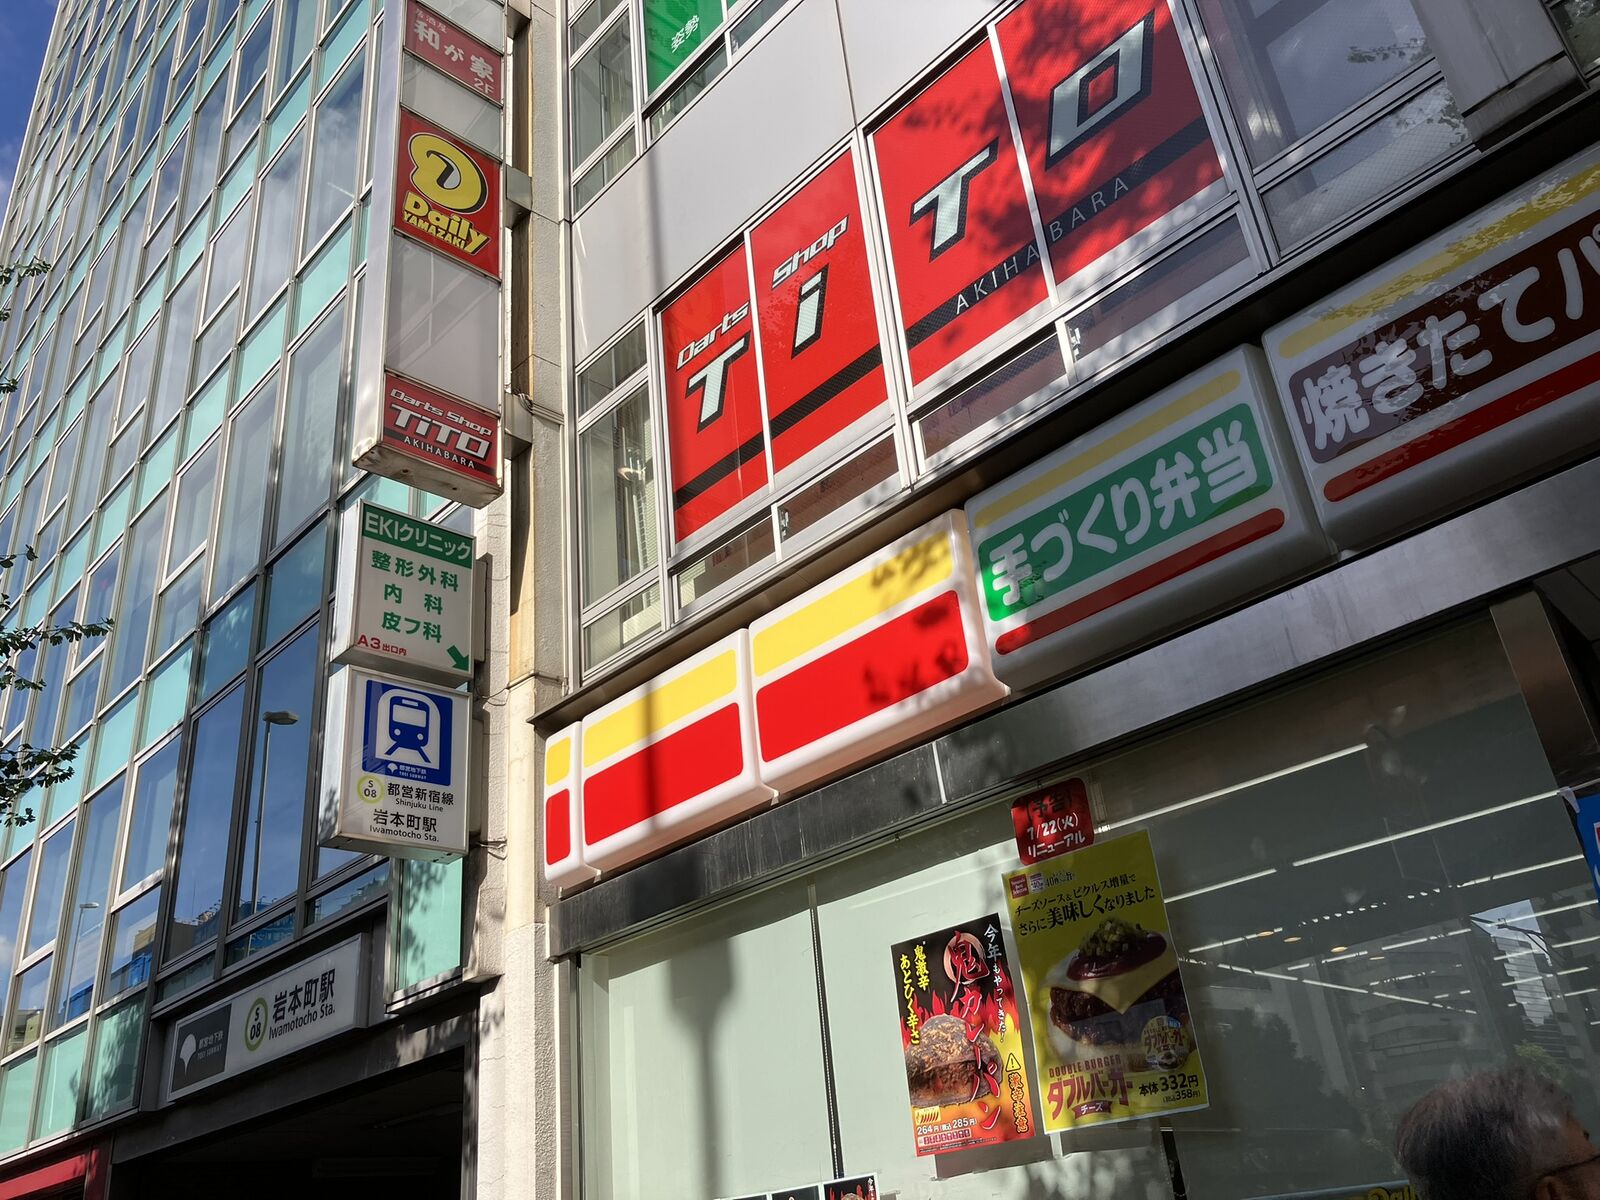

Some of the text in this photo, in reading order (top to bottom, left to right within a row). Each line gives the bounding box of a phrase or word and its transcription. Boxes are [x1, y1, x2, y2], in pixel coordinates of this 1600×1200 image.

[413, 20, 494, 82] 和が家
[474, 77, 495, 94] 2F
[403, 191, 490, 255] Daily
[403, 209, 466, 250] YAMAZAKI
[956, 176, 1129, 315] AKIHABARA
[676, 214, 850, 371] Darts Shop
[390, 388, 492, 436] Darts Shop
[404, 436, 475, 469] AKIHABARA
[987, 419, 1259, 607] 手づくり弁当
[365, 511, 471, 560] EKIクリニック
[371, 550, 459, 593] 整形外科
[381, 611, 442, 644] 皮フ科
[363, 788, 377, 798] 08
[368, 780, 374, 788] S
[387, 782, 454, 806] 都営新宿線
[373, 809, 437, 833] 岩本町駅
[395, 798, 444, 812] Shinjuku Line
[369, 825, 439, 842] Iwamotocho Sta.
[1027, 831, 1086, 858] リニューアル
[1018, 886, 1156, 936] さらに美味しくなりました
[254, 1007, 260, 1022] S
[272, 968, 336, 1023] 岩本町駅
[900, 953, 920, 1045] あとひく辛さ
[250, 1022, 262, 1041] 08
[269, 1003, 336, 1041] Iwamotocho Sta.
[947, 931, 1001, 1130] 鬼カレーパン
[1049, 1061, 1083, 1078] DOUBLE
[1084, 1054, 1122, 1072] BURGER
[1047, 1070, 1133, 1120] ダブルバーガー
[1081, 1101, 1104, 1115] チーズ
